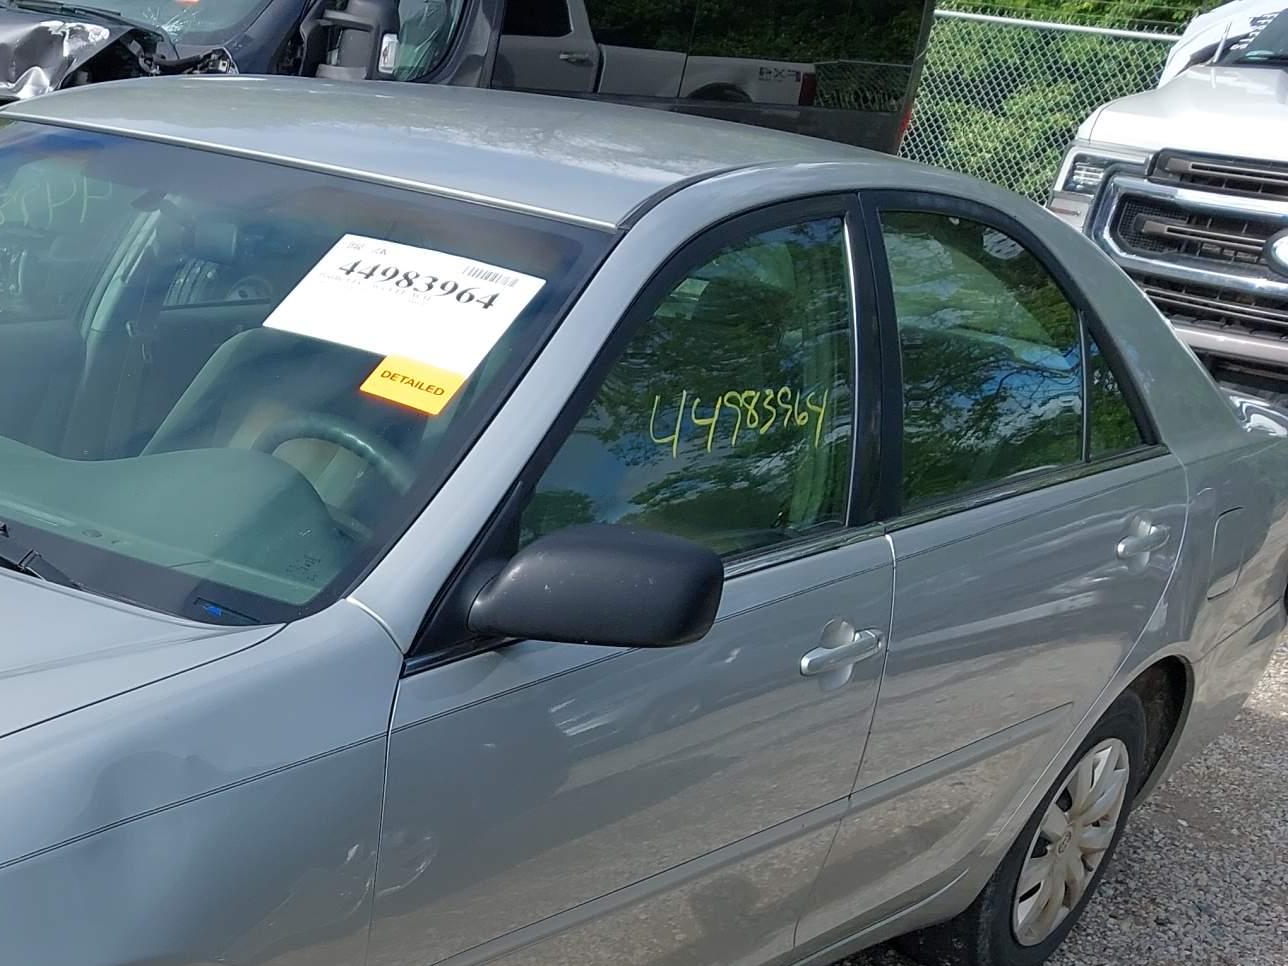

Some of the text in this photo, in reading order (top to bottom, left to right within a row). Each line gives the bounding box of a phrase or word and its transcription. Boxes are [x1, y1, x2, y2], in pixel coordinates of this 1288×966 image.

[338, 258, 501, 311] 44983964
[379, 369, 445, 397] DETAILED
[649, 385, 829, 459] 44983964
